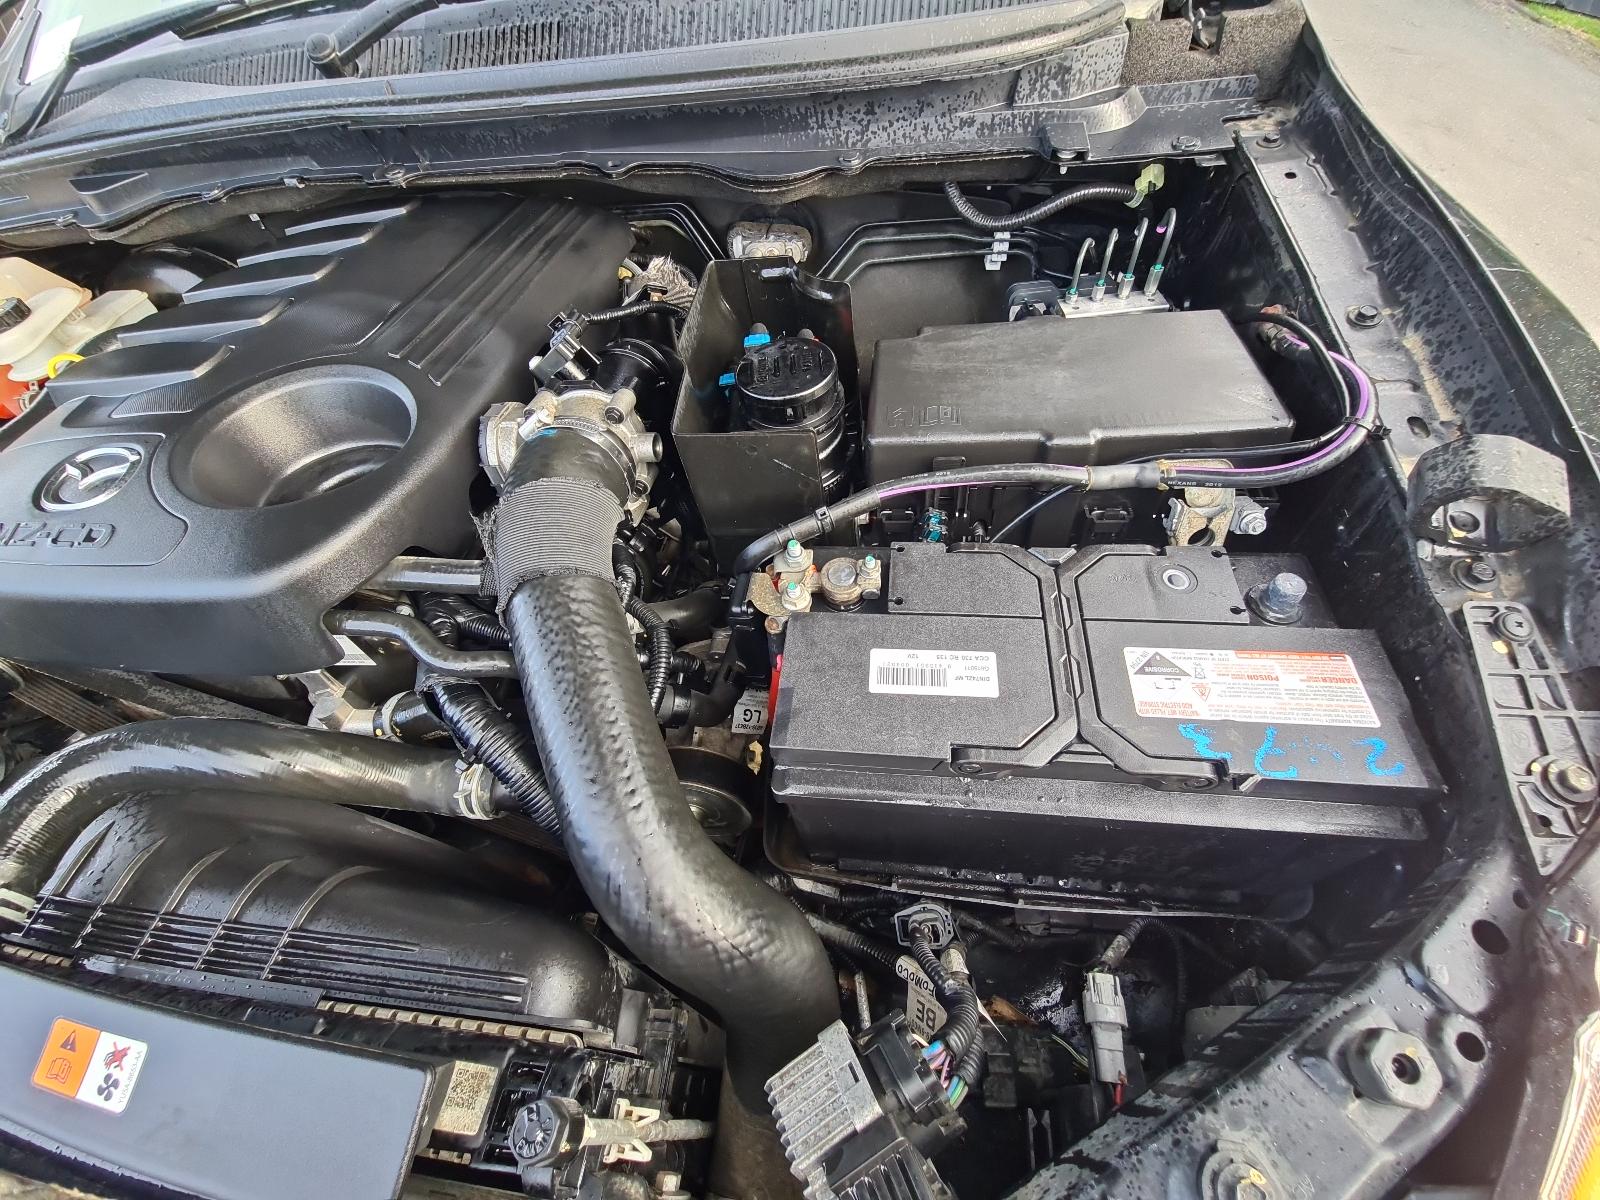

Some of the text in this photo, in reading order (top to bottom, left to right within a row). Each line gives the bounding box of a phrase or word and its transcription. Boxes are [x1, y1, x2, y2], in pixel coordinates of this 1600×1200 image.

[1246, 674, 1280, 682] POISON
[1320, 676, 1358, 685] DANGER
[742, 709, 761, 723] LG
[915, 999, 937, 1032] BE
